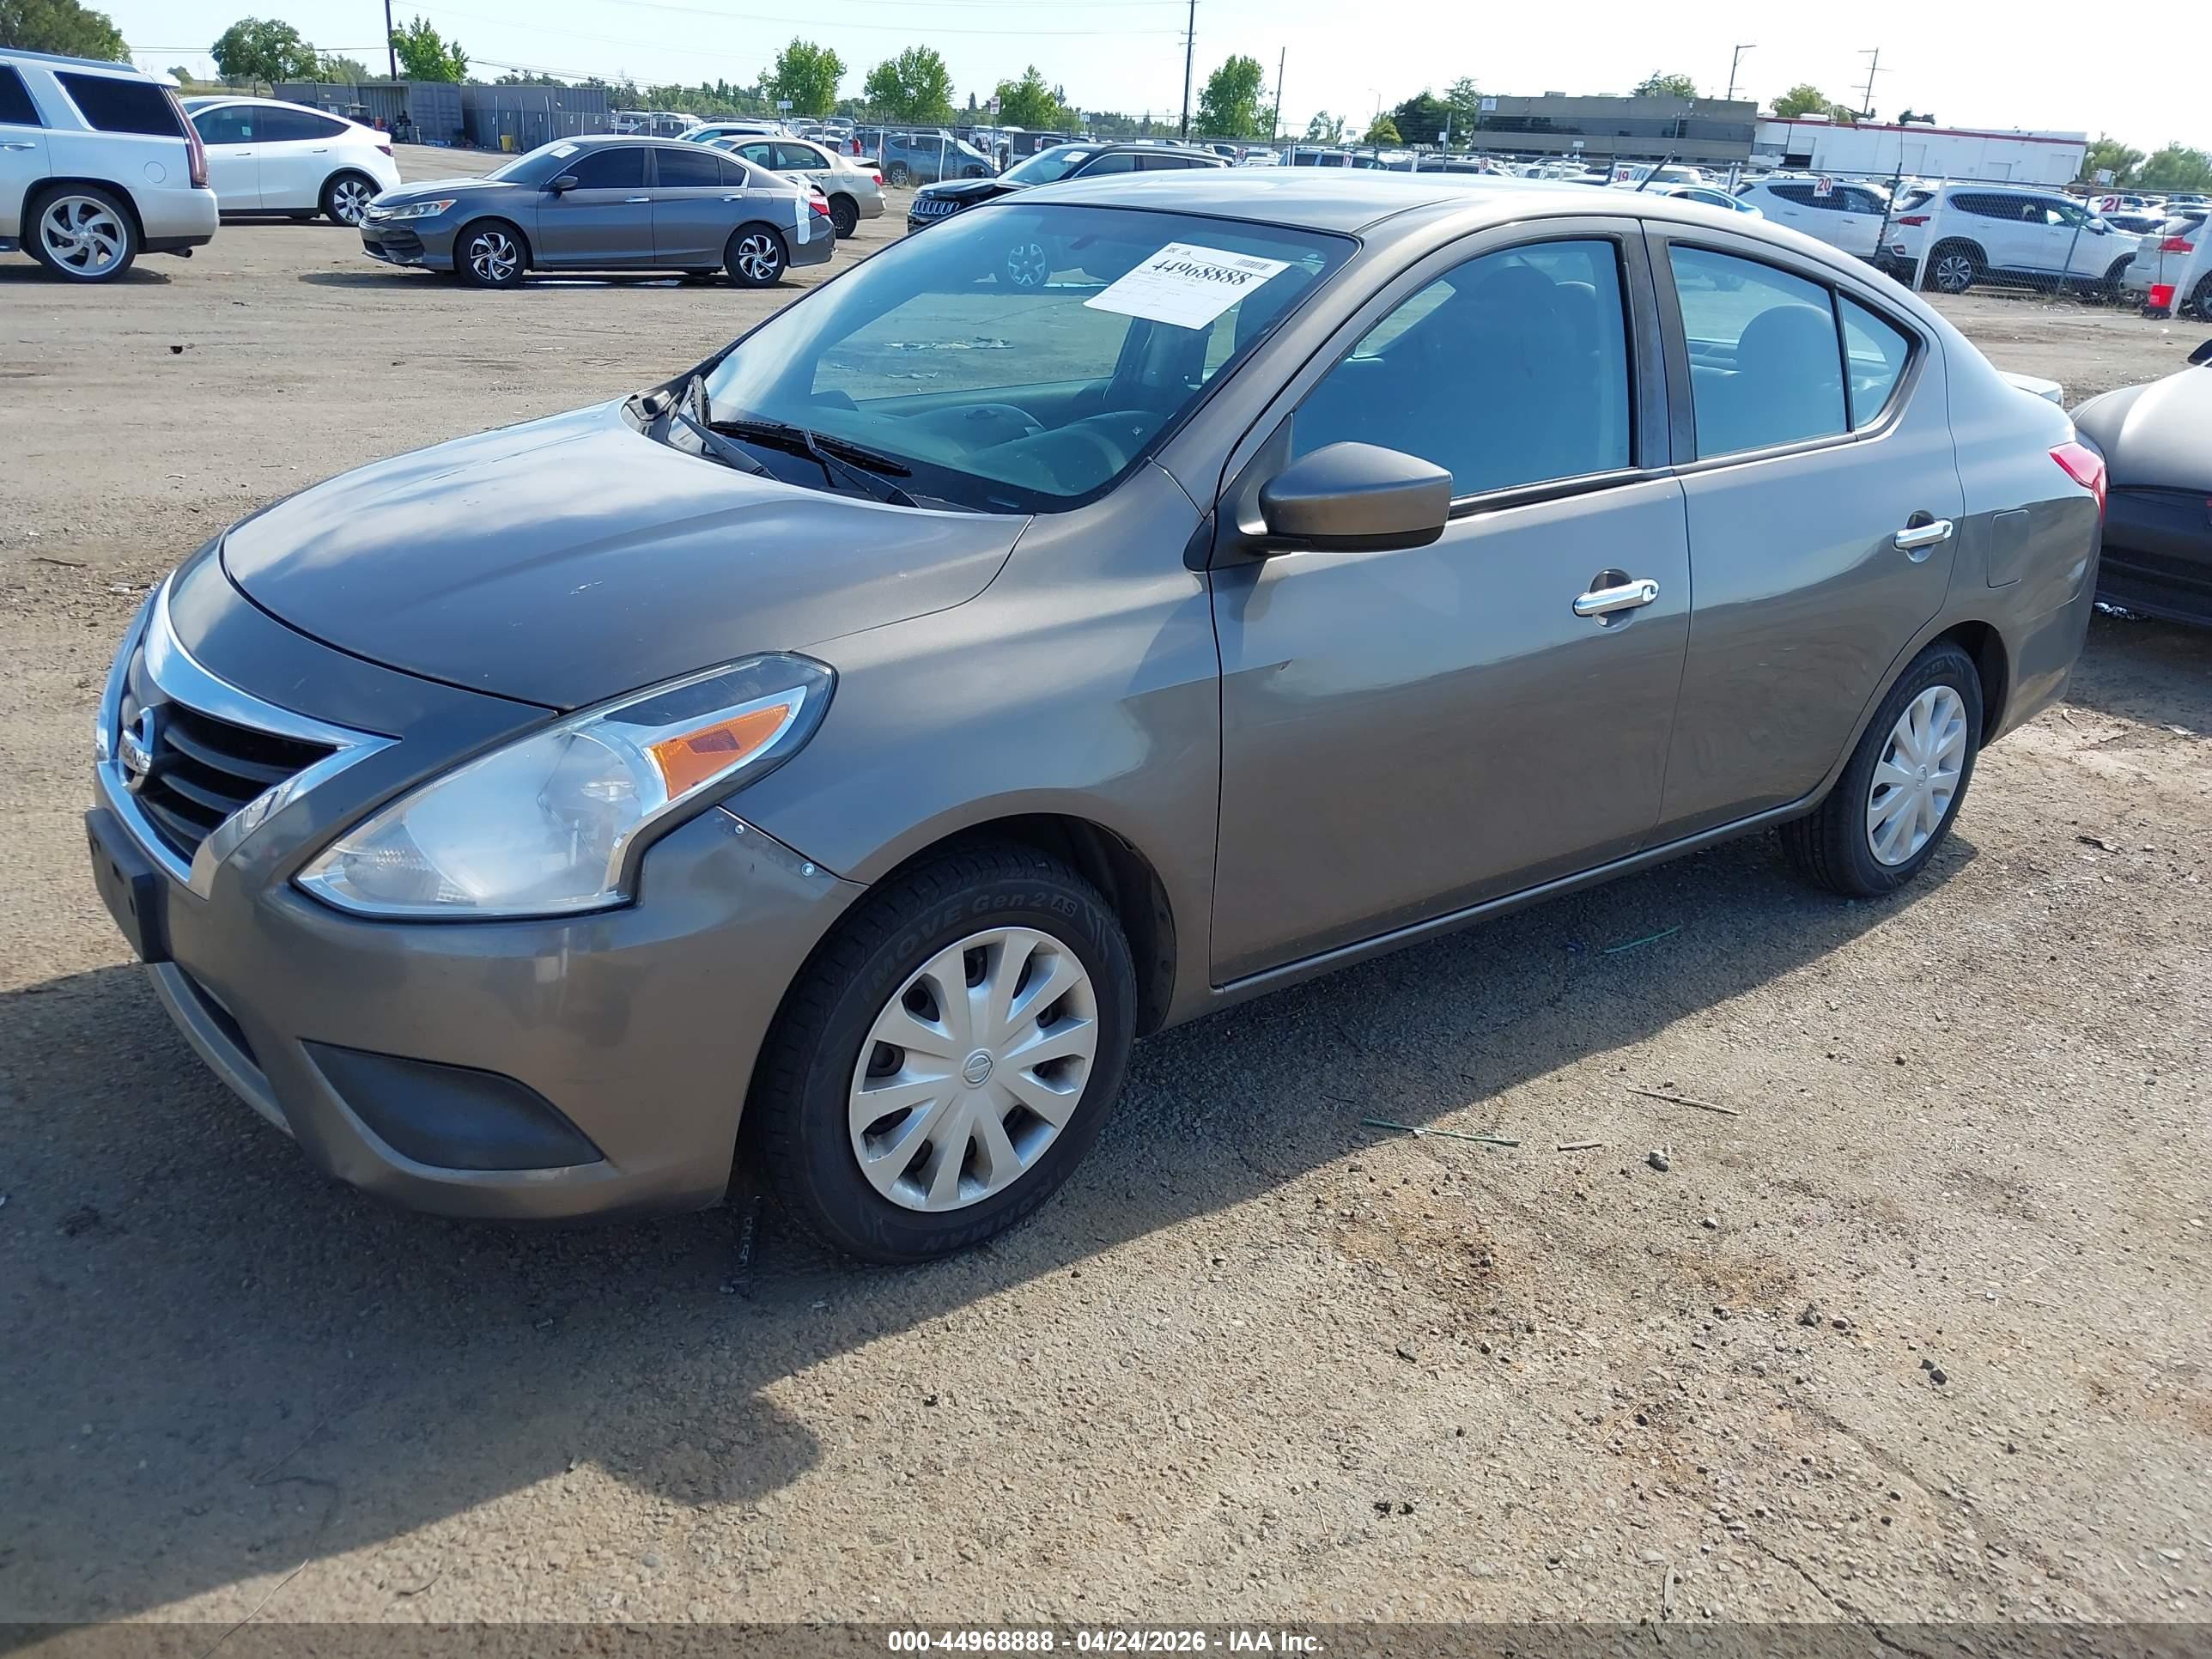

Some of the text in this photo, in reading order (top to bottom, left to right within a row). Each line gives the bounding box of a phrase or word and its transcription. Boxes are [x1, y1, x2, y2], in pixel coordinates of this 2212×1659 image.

[1237, 148, 1244, 159] 16
[1343, 155, 1352, 166] 17
[1480, 159, 1488, 170] 18
[1618, 171, 1629, 182] 19
[1816, 178, 1832, 191] 20
[2101, 198, 2122, 212] 21
[1152, 258, 1253, 287] 44968888
[972, 893, 1026, 913] Gen
[1027, 891, 1048, 908] 2
[1052, 896, 1076, 916] AS
